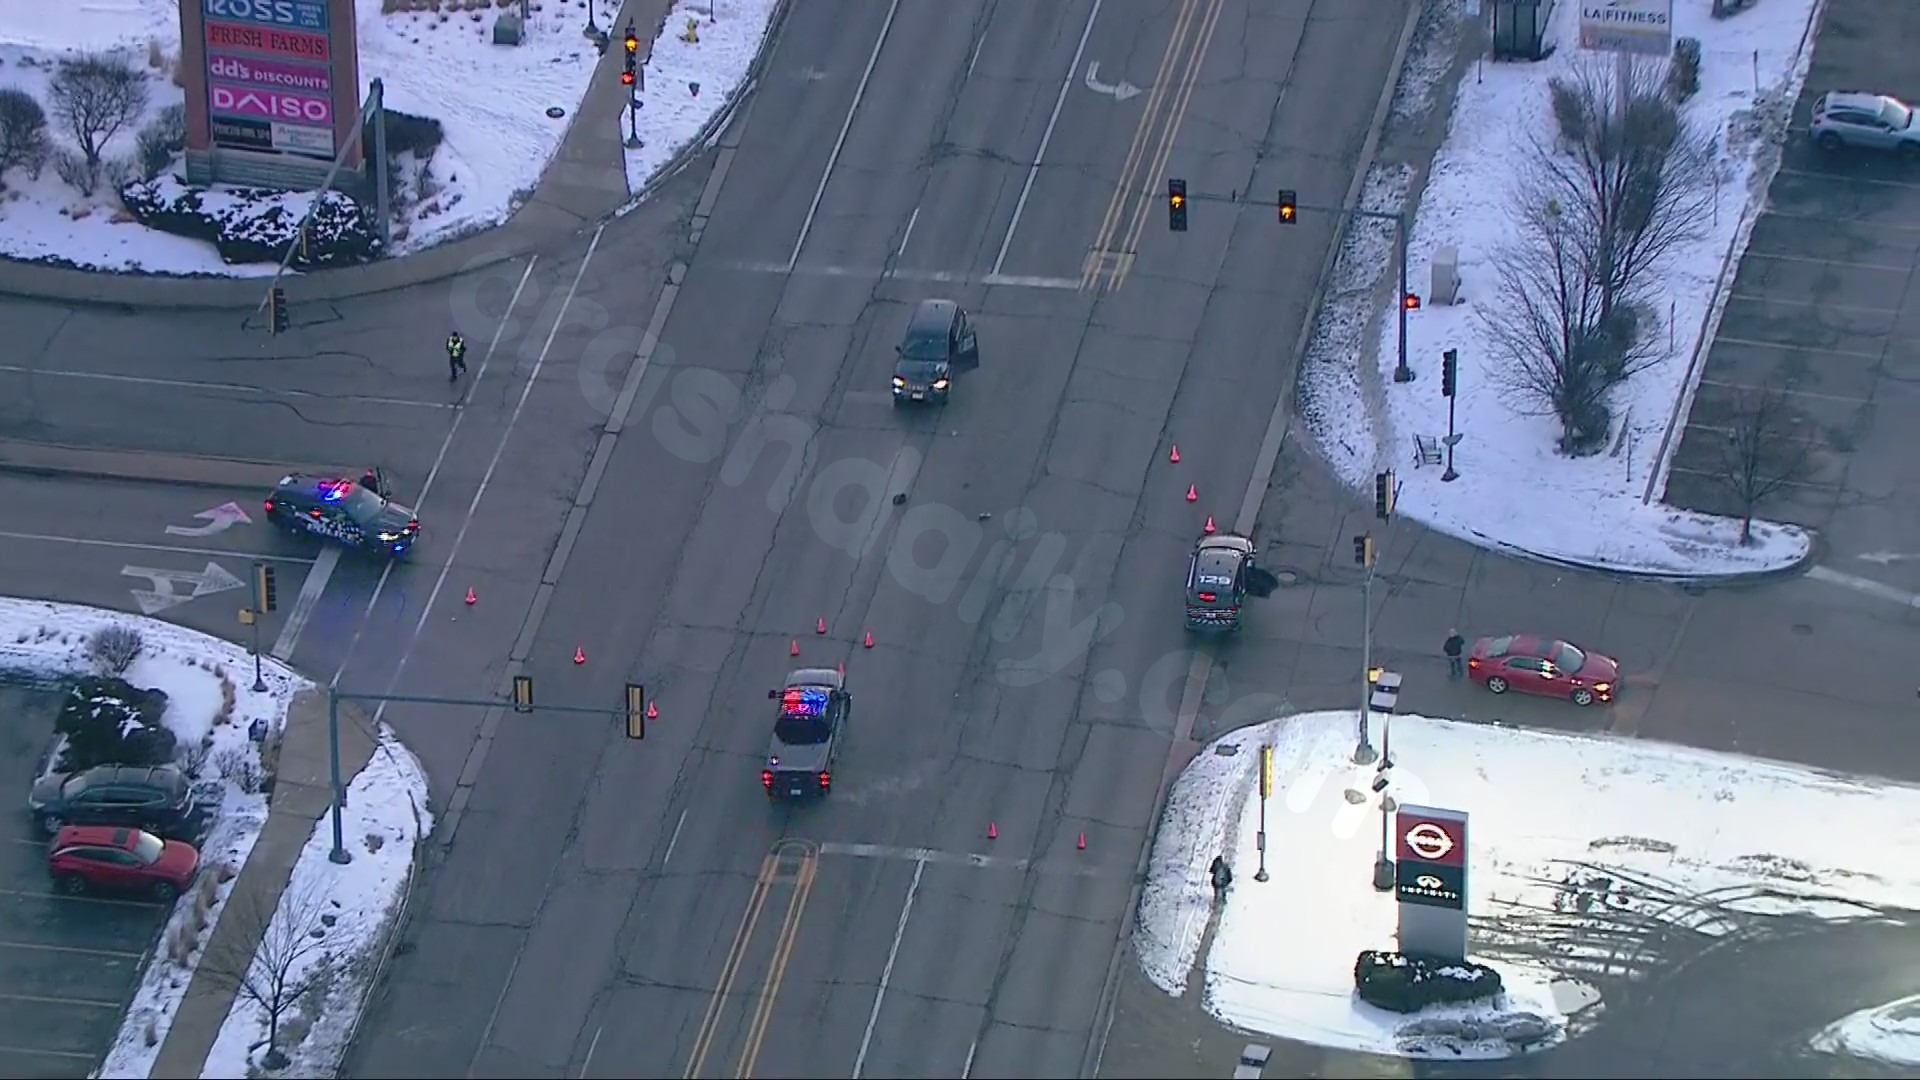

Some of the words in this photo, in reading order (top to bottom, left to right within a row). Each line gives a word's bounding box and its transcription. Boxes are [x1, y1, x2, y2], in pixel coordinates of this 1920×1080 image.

[206, 0, 294, 23] ROSS
[211, 26, 262, 48] FRESH
[271, 33, 324, 56] FARMS
[211, 58, 250, 80] dd's
[254, 70, 329, 89] DISCOUNTS
[213, 87, 328, 120] DAISO
